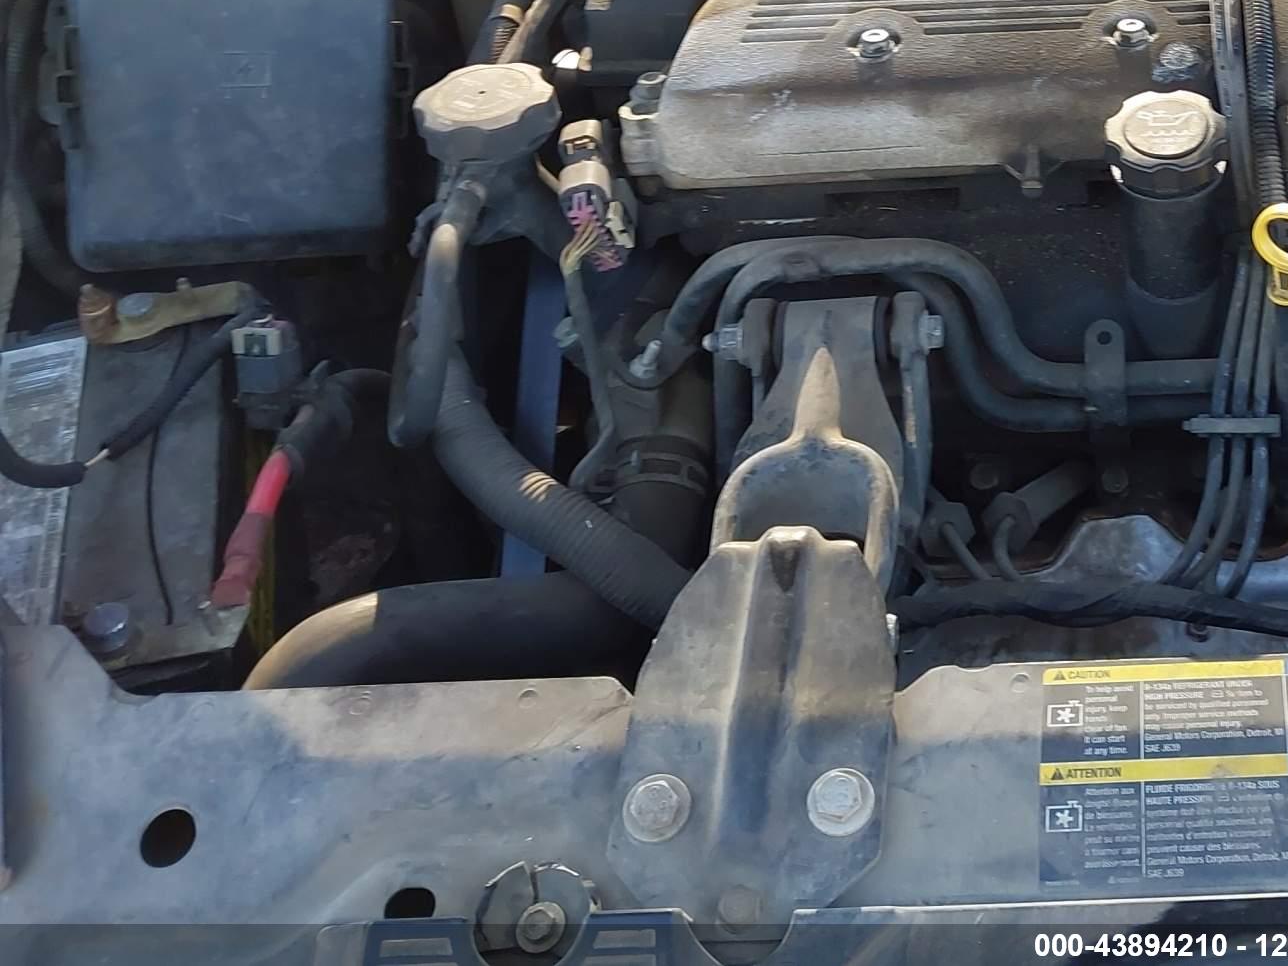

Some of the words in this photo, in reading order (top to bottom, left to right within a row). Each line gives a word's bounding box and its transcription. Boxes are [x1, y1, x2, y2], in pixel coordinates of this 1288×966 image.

[1068, 670, 1111, 680] CAUTION
[1066, 767, 1122, 779] ATTENTION
[1258, 780, 1280, 789] SOUS
[1177, 856, 1204, 865] Motors
